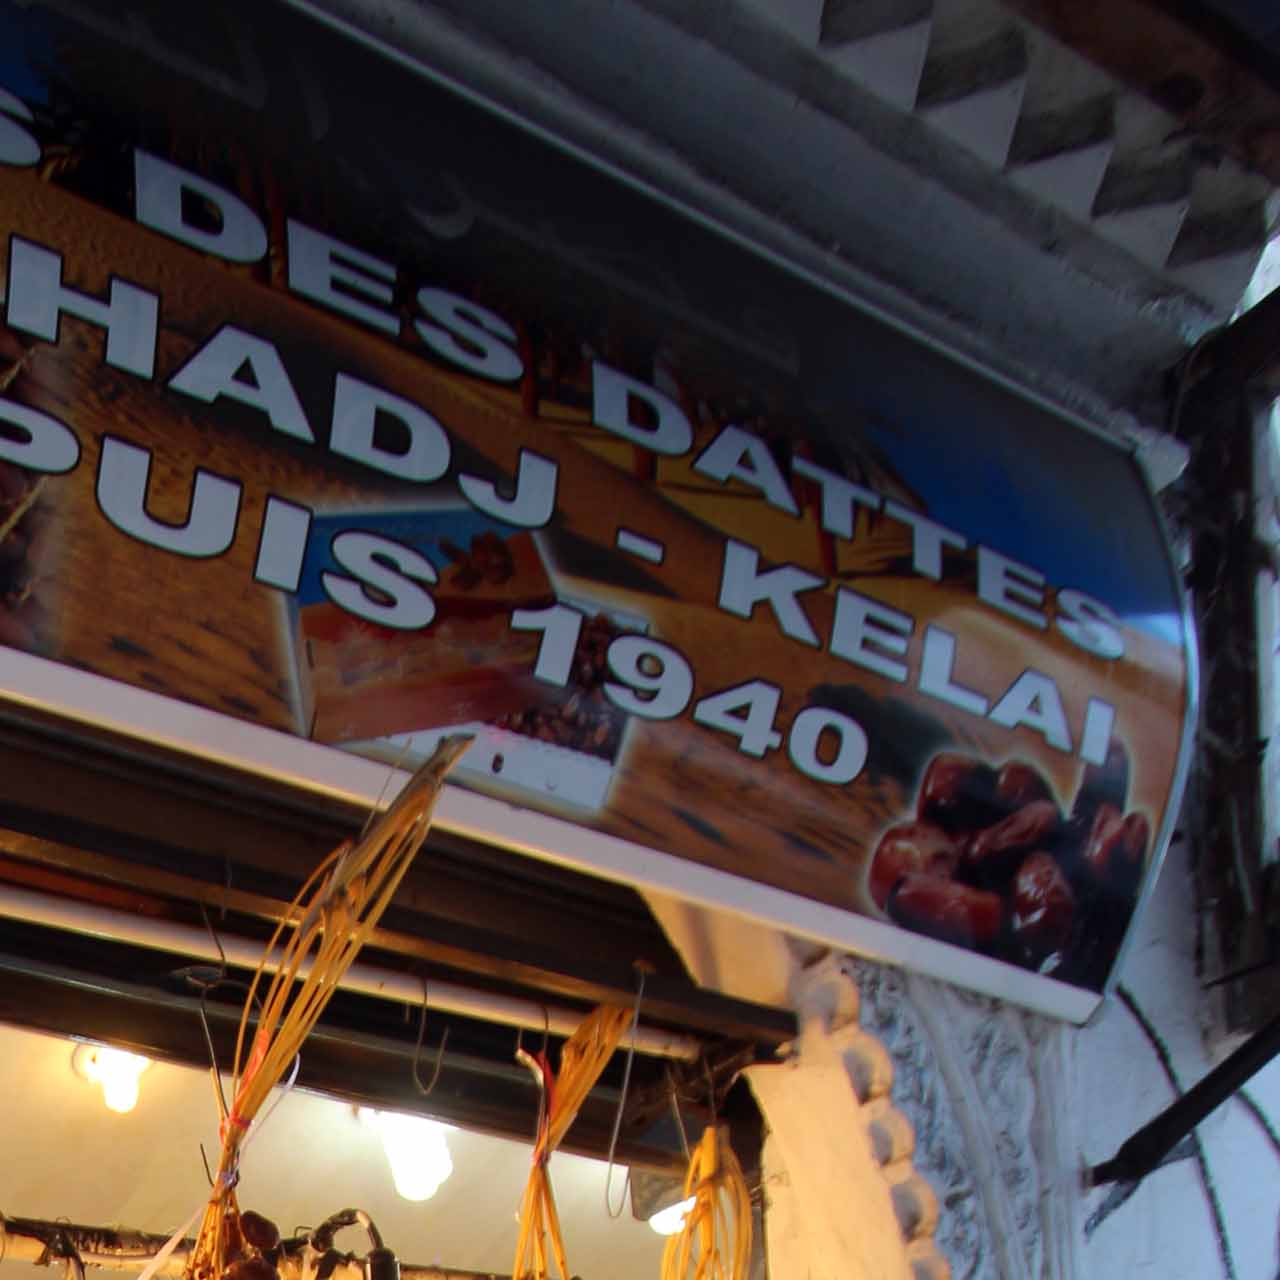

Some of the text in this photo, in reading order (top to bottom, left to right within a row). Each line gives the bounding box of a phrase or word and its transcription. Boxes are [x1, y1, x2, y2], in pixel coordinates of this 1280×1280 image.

[7, 235, 558, 529] HADJ
[719, 540, 1116, 766] KELAI
[134, 148, 523, 383] DES
[592, 362, 1123, 660] DATTES
[511, 602, 869, 785] 1940
